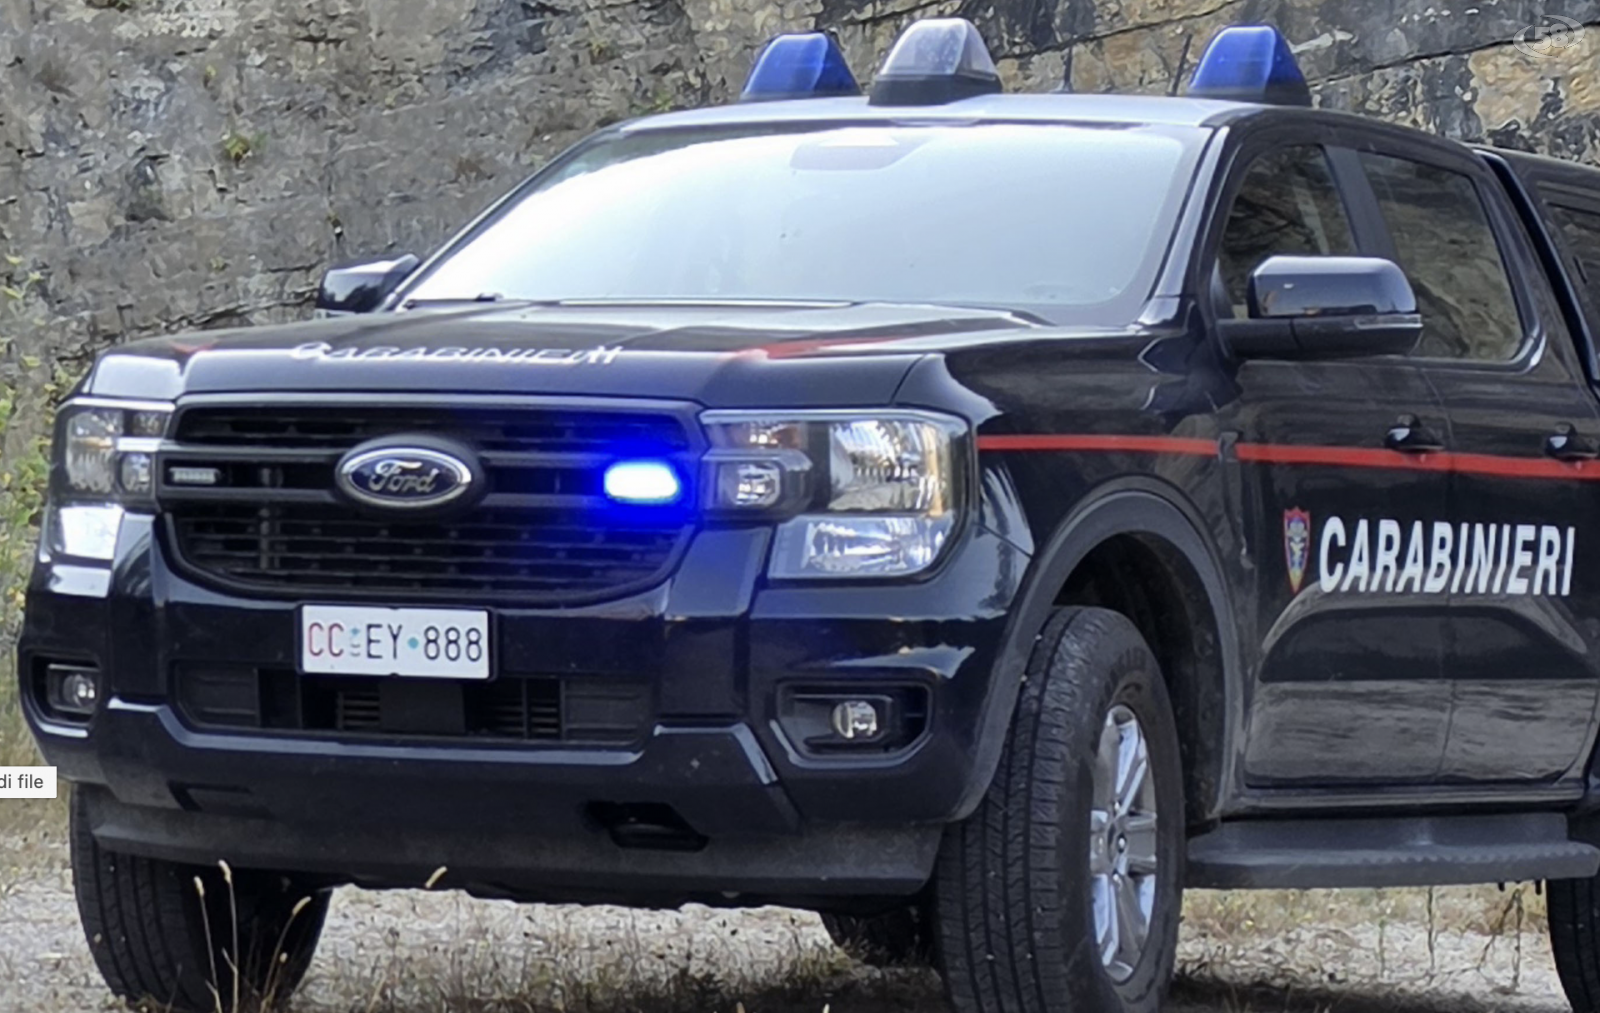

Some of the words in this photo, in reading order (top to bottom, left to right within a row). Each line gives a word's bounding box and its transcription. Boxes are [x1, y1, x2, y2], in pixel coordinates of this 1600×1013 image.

[368, 459, 440, 493] Ford
[1319, 516, 1575, 596] CARABINIERI
[308, 622, 345, 658] CC
[366, 623, 403, 660] EY
[423, 626, 483, 662] 888
